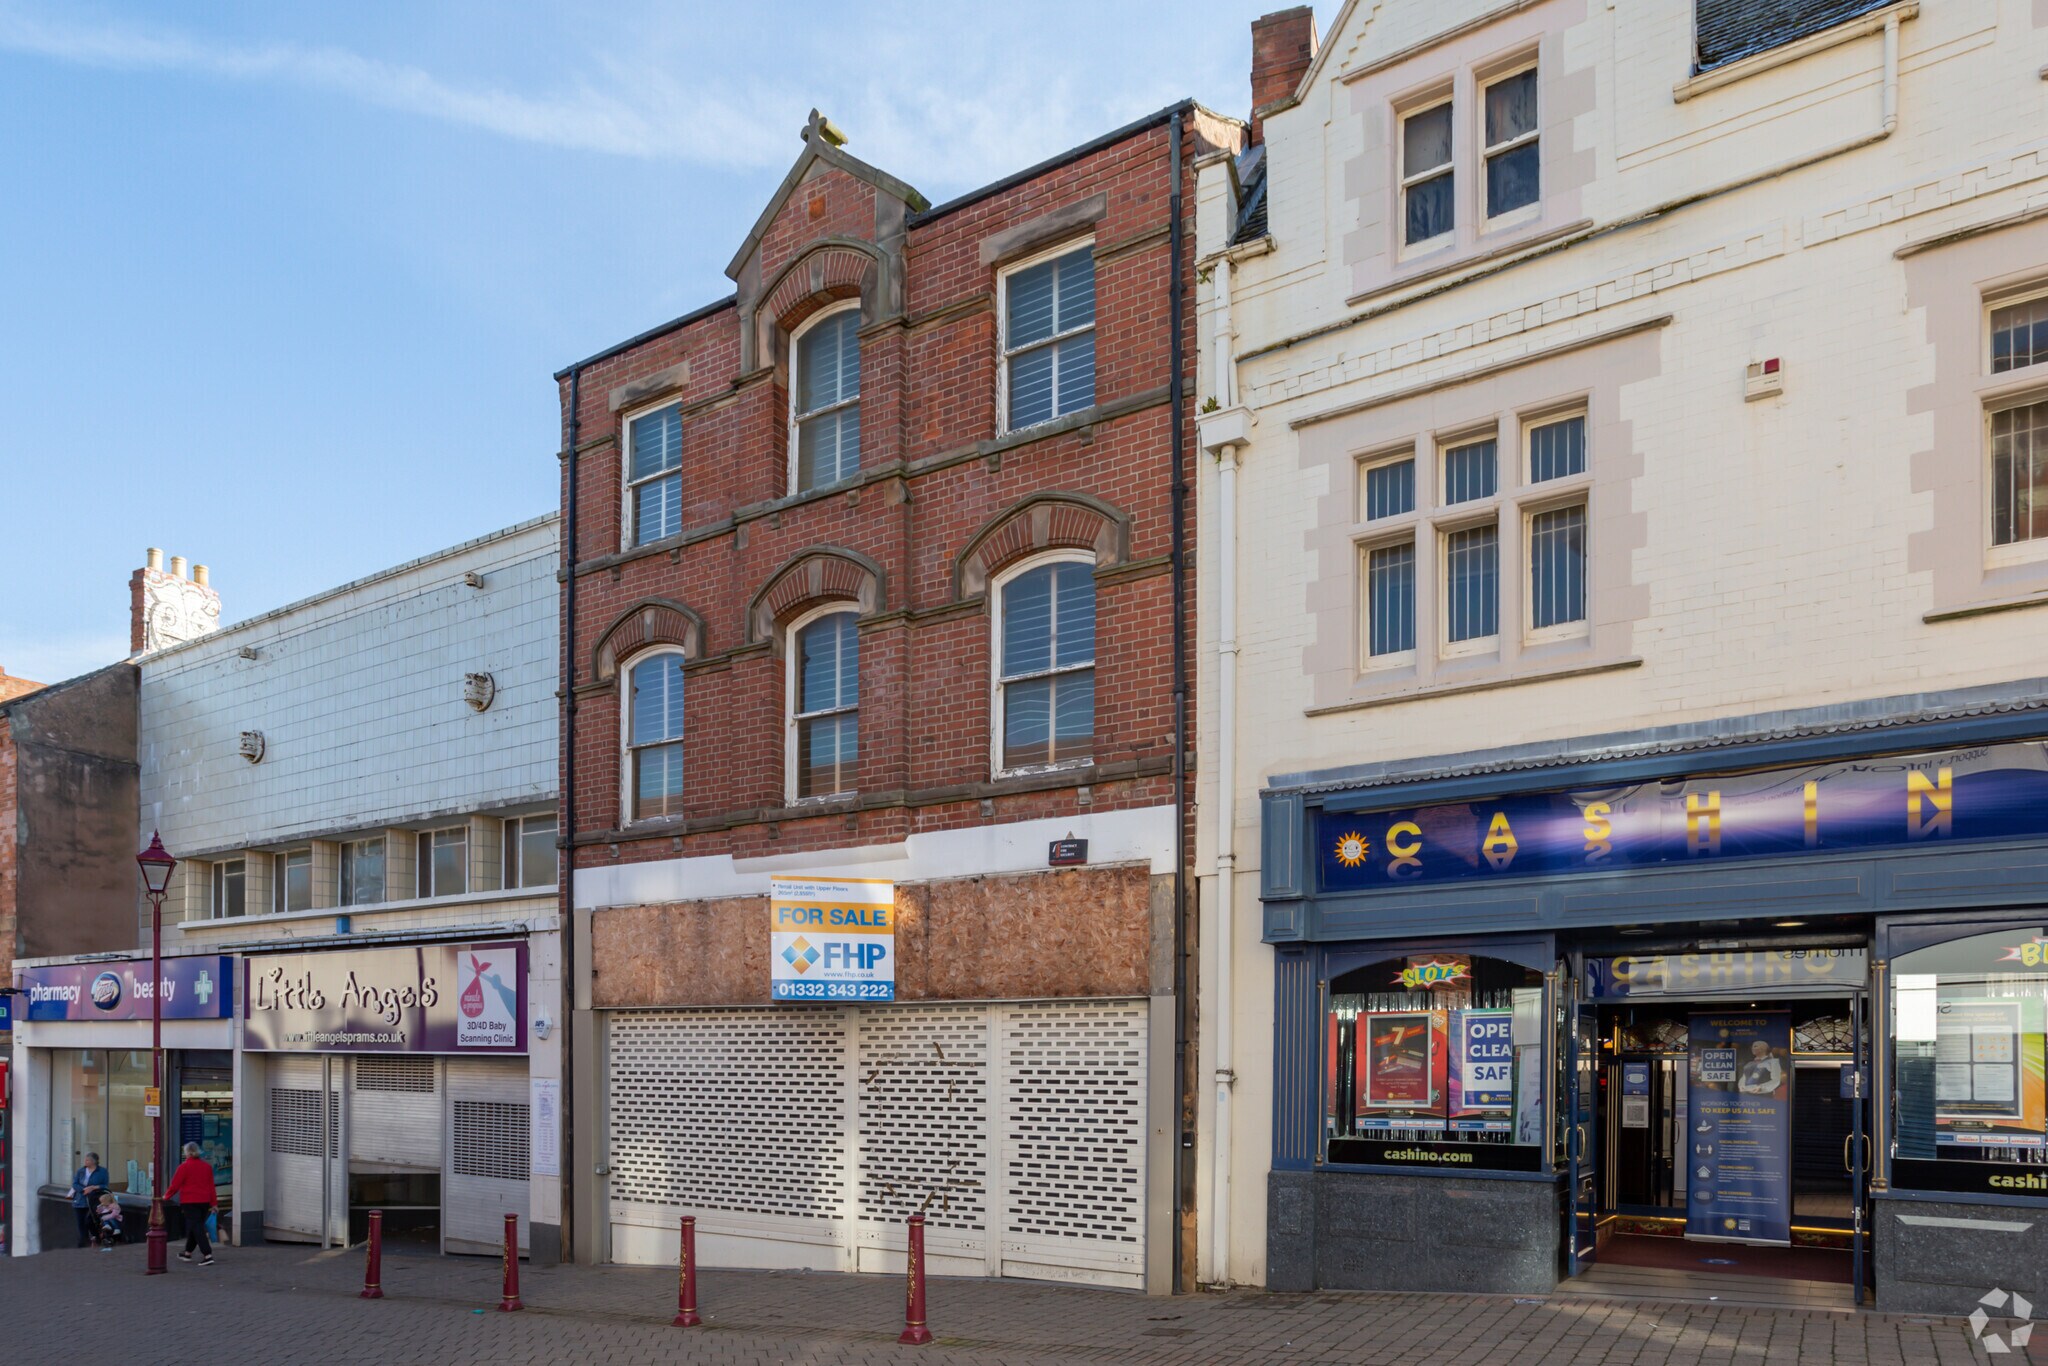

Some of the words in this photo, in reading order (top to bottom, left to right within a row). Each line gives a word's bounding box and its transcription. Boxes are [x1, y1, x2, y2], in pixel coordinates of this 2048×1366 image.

[778, 907, 823, 925] FOR
[829, 908, 886, 926] SALE
[823, 942, 886, 969] FHP
[1611, 949, 1836, 980] CASHINO
[1402, 964, 1466, 988] SLOTS
[30, 982, 81, 1004] pharmacy
[255, 966, 326, 1011] Little
[338, 971, 438, 1026] Angels
[779, 983, 824, 996] 01332
[827, 984, 856, 996] 343
[859, 984, 888, 997] 222
[467, 1021, 488, 1030] 3D/4D
[489, 1021, 506, 1032] Baby
[1470, 1023, 1512, 1038] OPE
[283, 1031, 404, 1045] www.ittleangelsprams.co.uk
[460, 1034, 491, 1044] Scanning
[494, 1034, 513, 1043] Clinic
[1391, 1027, 1405, 1045] 7
[1470, 1044, 1512, 1057] CLEA
[1705, 1052, 1733, 1060] OPEN
[1474, 1066, 1512, 1081] SAF
[1384, 1149, 1473, 1163] cashino.com
[1988, 1173, 2048, 1189] cashi
